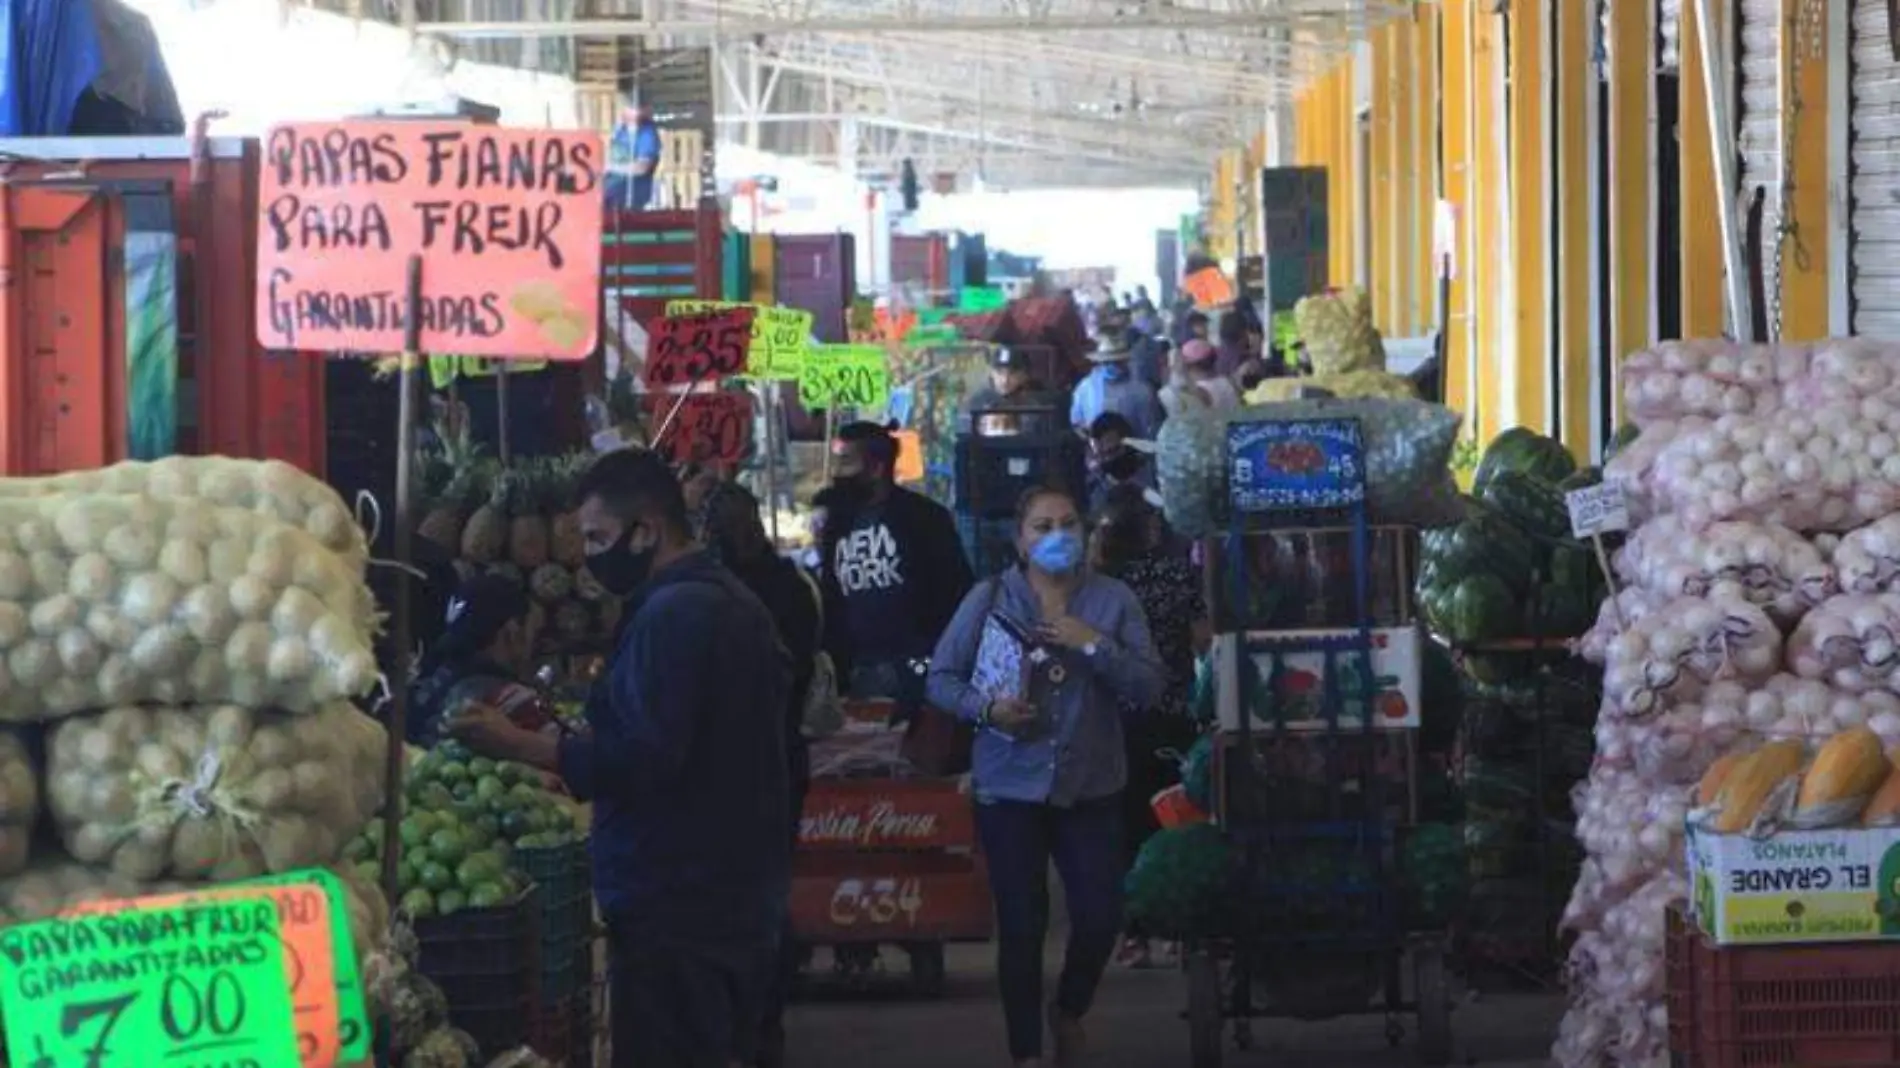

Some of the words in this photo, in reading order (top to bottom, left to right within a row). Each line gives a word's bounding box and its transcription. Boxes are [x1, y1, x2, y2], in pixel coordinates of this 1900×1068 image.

[269, 127, 407, 187] PAPAS
[422, 131, 597, 194] FIANAS
[268, 194, 391, 250] PARA
[413, 200, 563, 269] FREIR
[269, 267, 503, 343] GARANTIADAS
[836, 523, 897, 561] NEW
[836, 557, 904, 597] YORK
[1754, 841, 1848, 862] PLATANOS
[1731, 866, 1833, 894] GRANDE
[1840, 865, 1871, 889] EL
[161, 966, 247, 1042] 00
